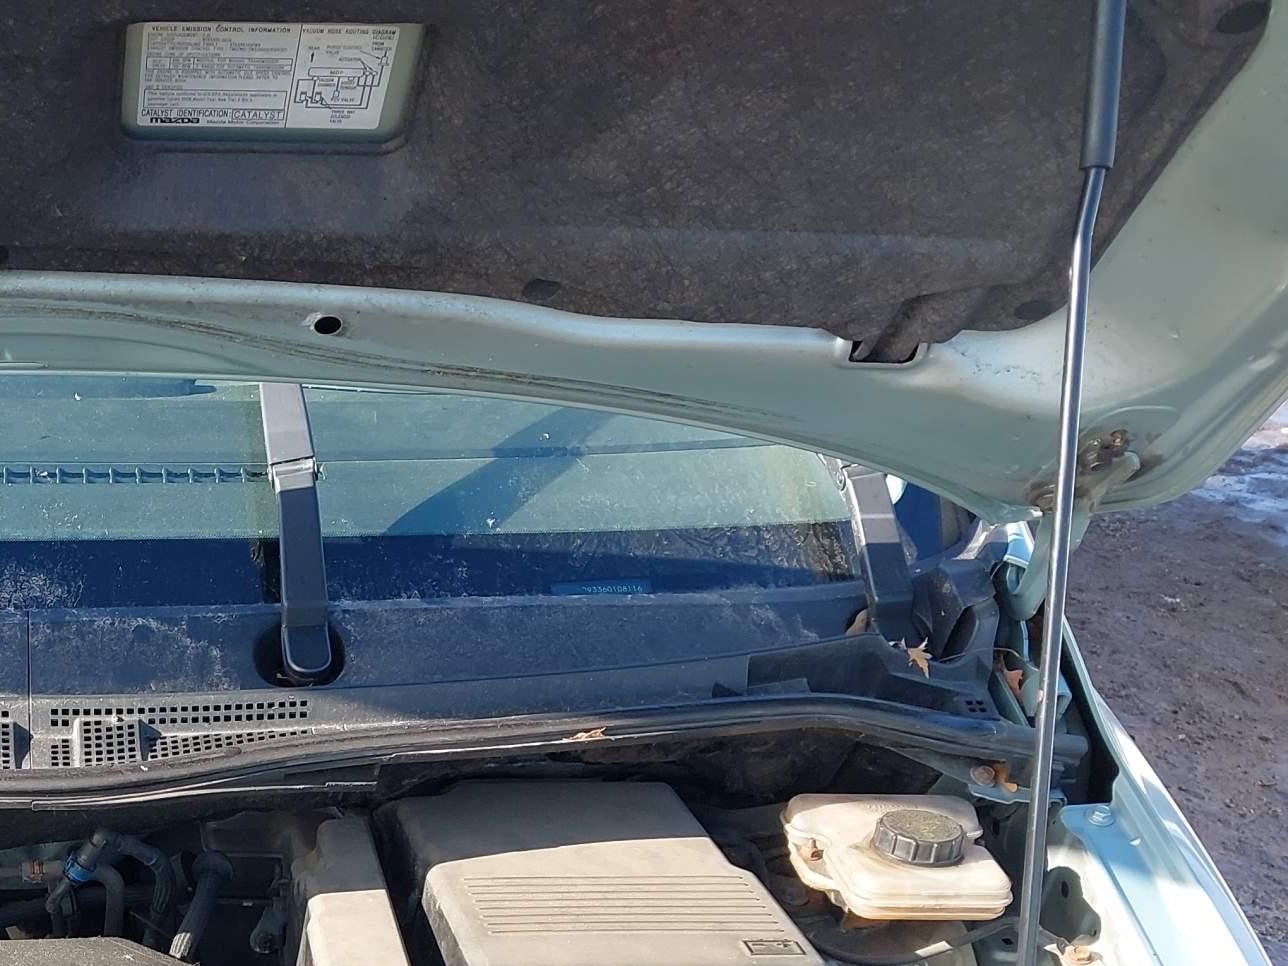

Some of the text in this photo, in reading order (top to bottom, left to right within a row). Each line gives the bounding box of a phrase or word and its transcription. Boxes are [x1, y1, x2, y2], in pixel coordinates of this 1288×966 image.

[215, 24, 244, 33] CONTROL
[141, 109, 282, 119] CATALYST IDENTIFICATION: CATALYST
